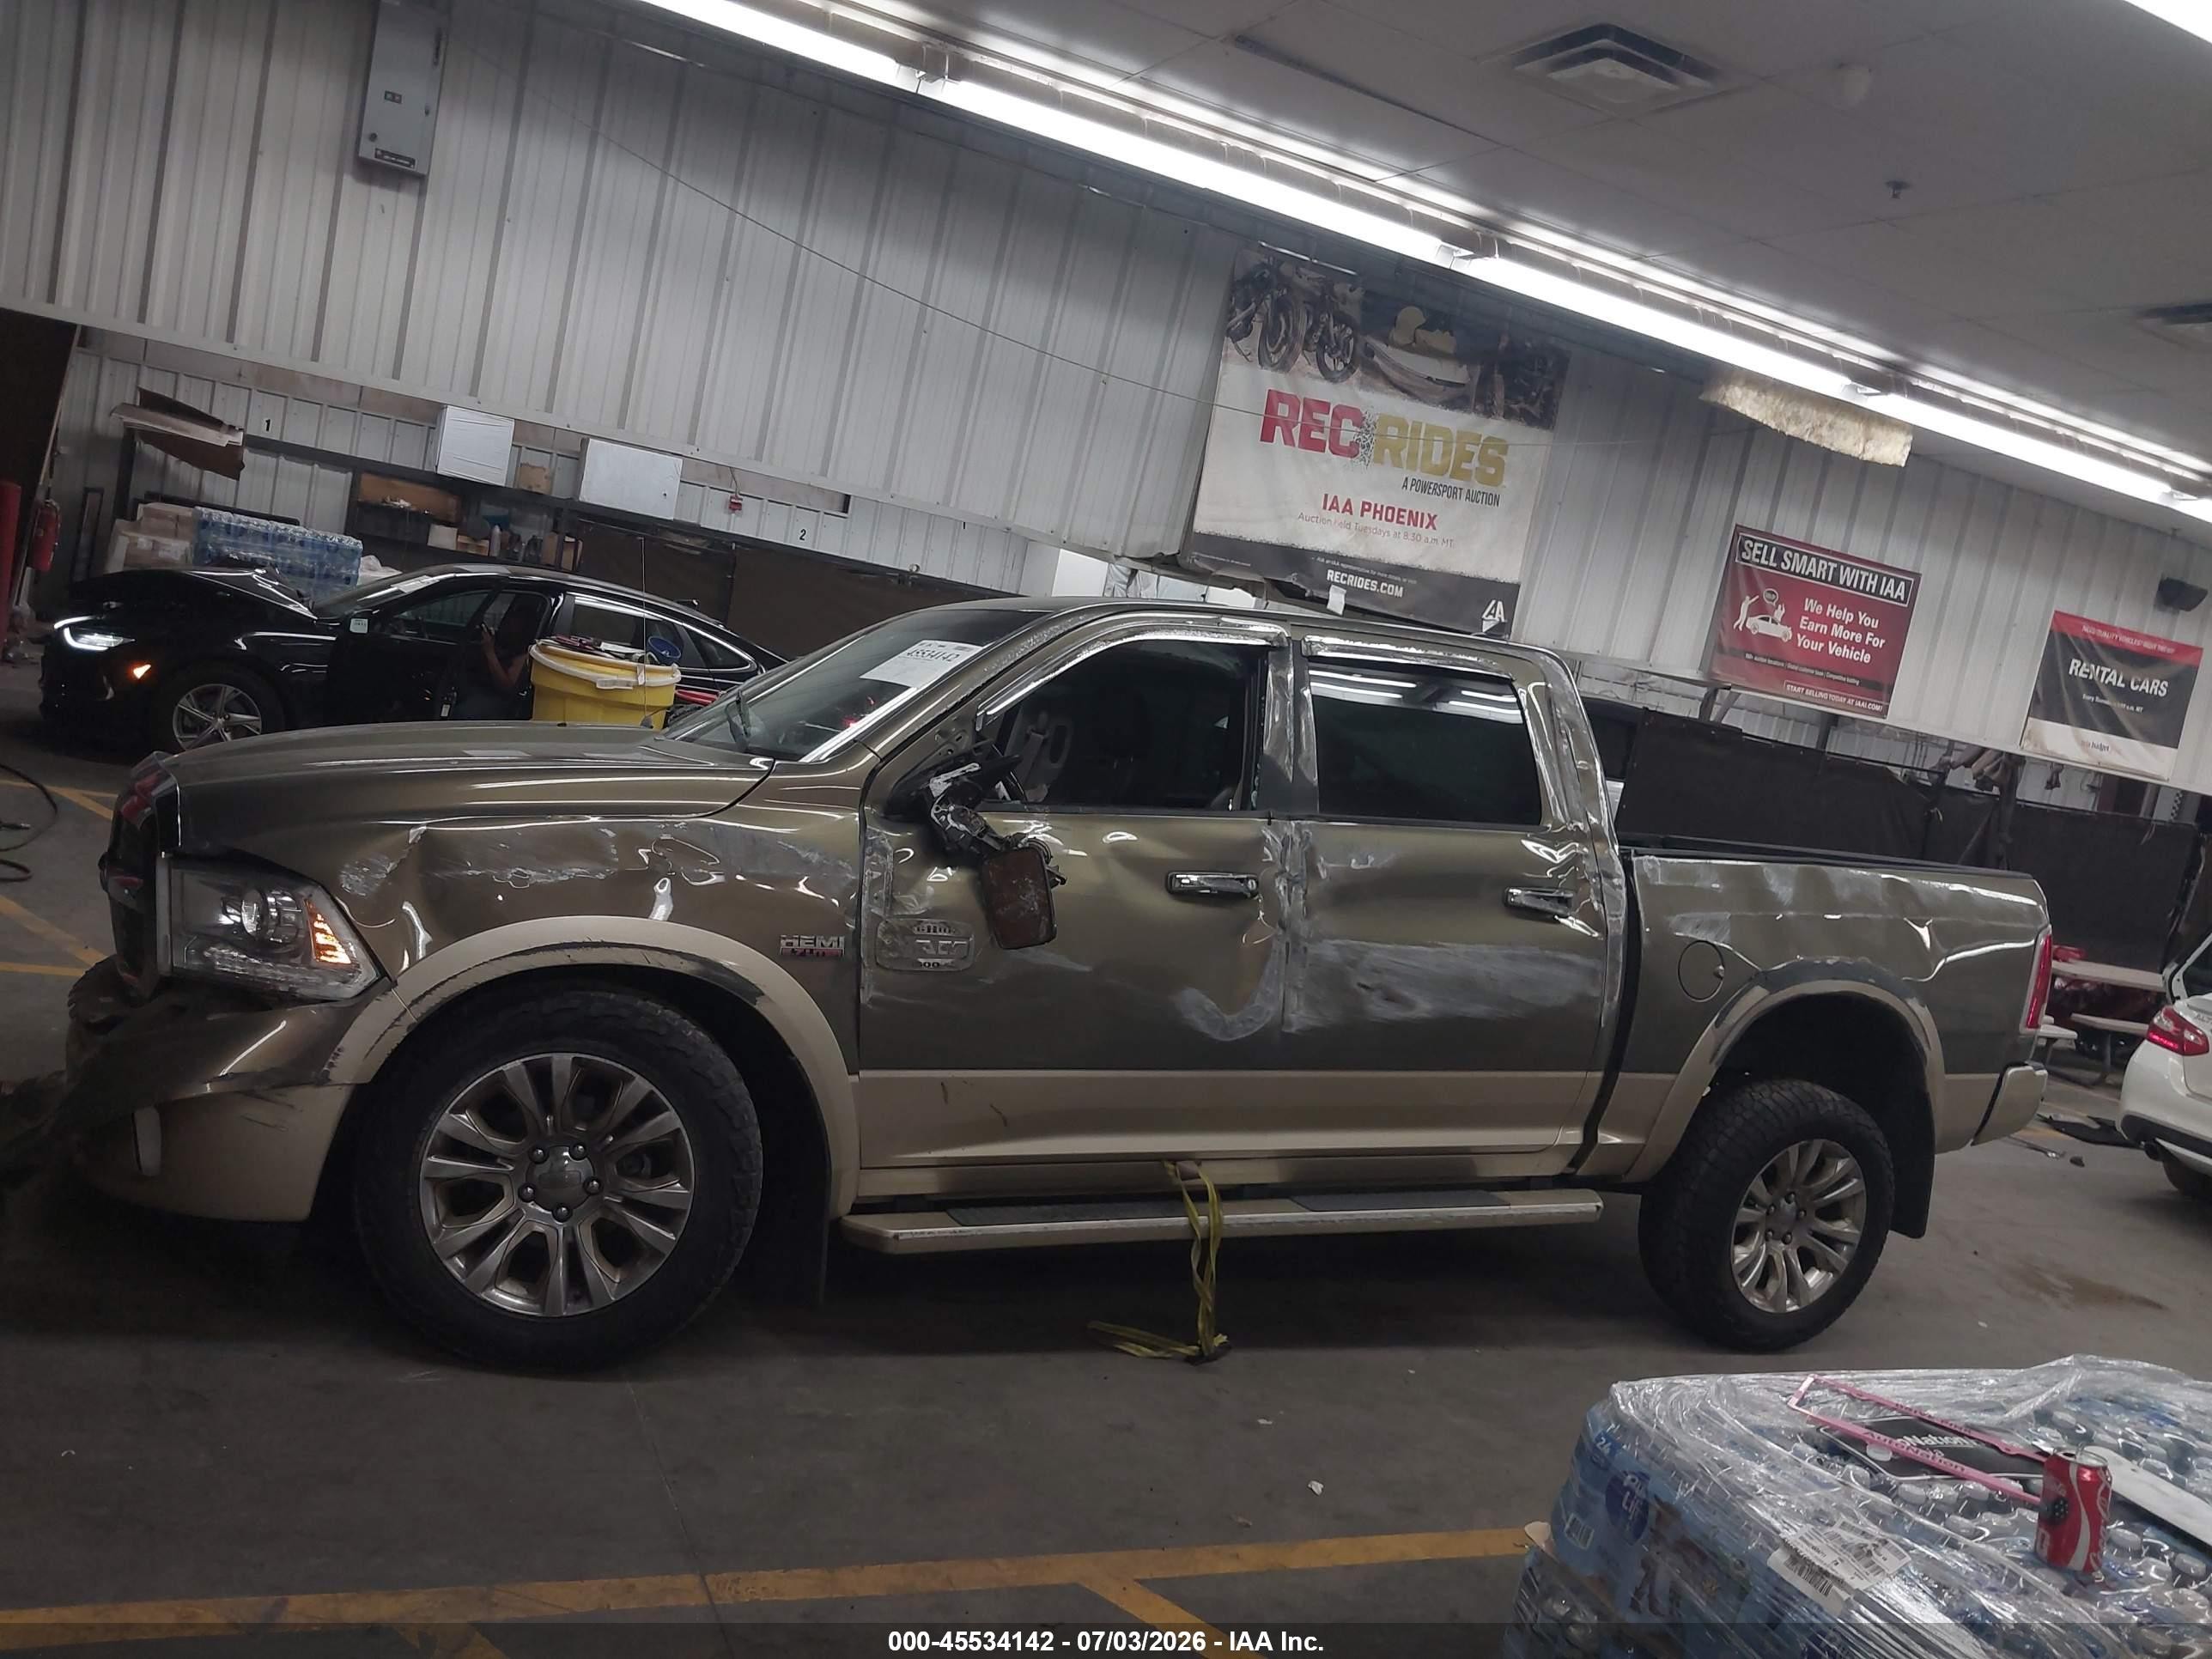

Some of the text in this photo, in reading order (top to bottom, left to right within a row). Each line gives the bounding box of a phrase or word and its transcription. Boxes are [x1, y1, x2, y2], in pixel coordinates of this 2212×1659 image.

[265, 418, 271, 432] 1
[1260, 389, 1510, 487] REC RIDES
[1401, 477, 1501, 507] A POWERSPORT AUCTION
[1297, 512, 1331, 526] Auction
[1354, 522, 1391, 537] Tuesdays
[1393, 531, 1401, 539] at
[1322, 493, 1438, 531] IAA PHOENIX
[799, 528, 806, 541] 2
[1327, 568, 1404, 599] RECRIDES.COM
[1741, 538, 1905, 601] SELL SMART WITH IAA
[1804, 598, 1880, 629] We Help You
[1799, 616, 1886, 649] Earn More For
[1796, 633, 1872, 664] Your Vehicle
[2069, 659, 2169, 697] RENTAL CARS
[1786, 684, 1805, 694] START
[1805, 687, 1828, 700] SELLING
[1828, 691, 1847, 703] TODAY
[1847, 697, 1855, 706] AT
[780, 935, 845, 948] HEMI
